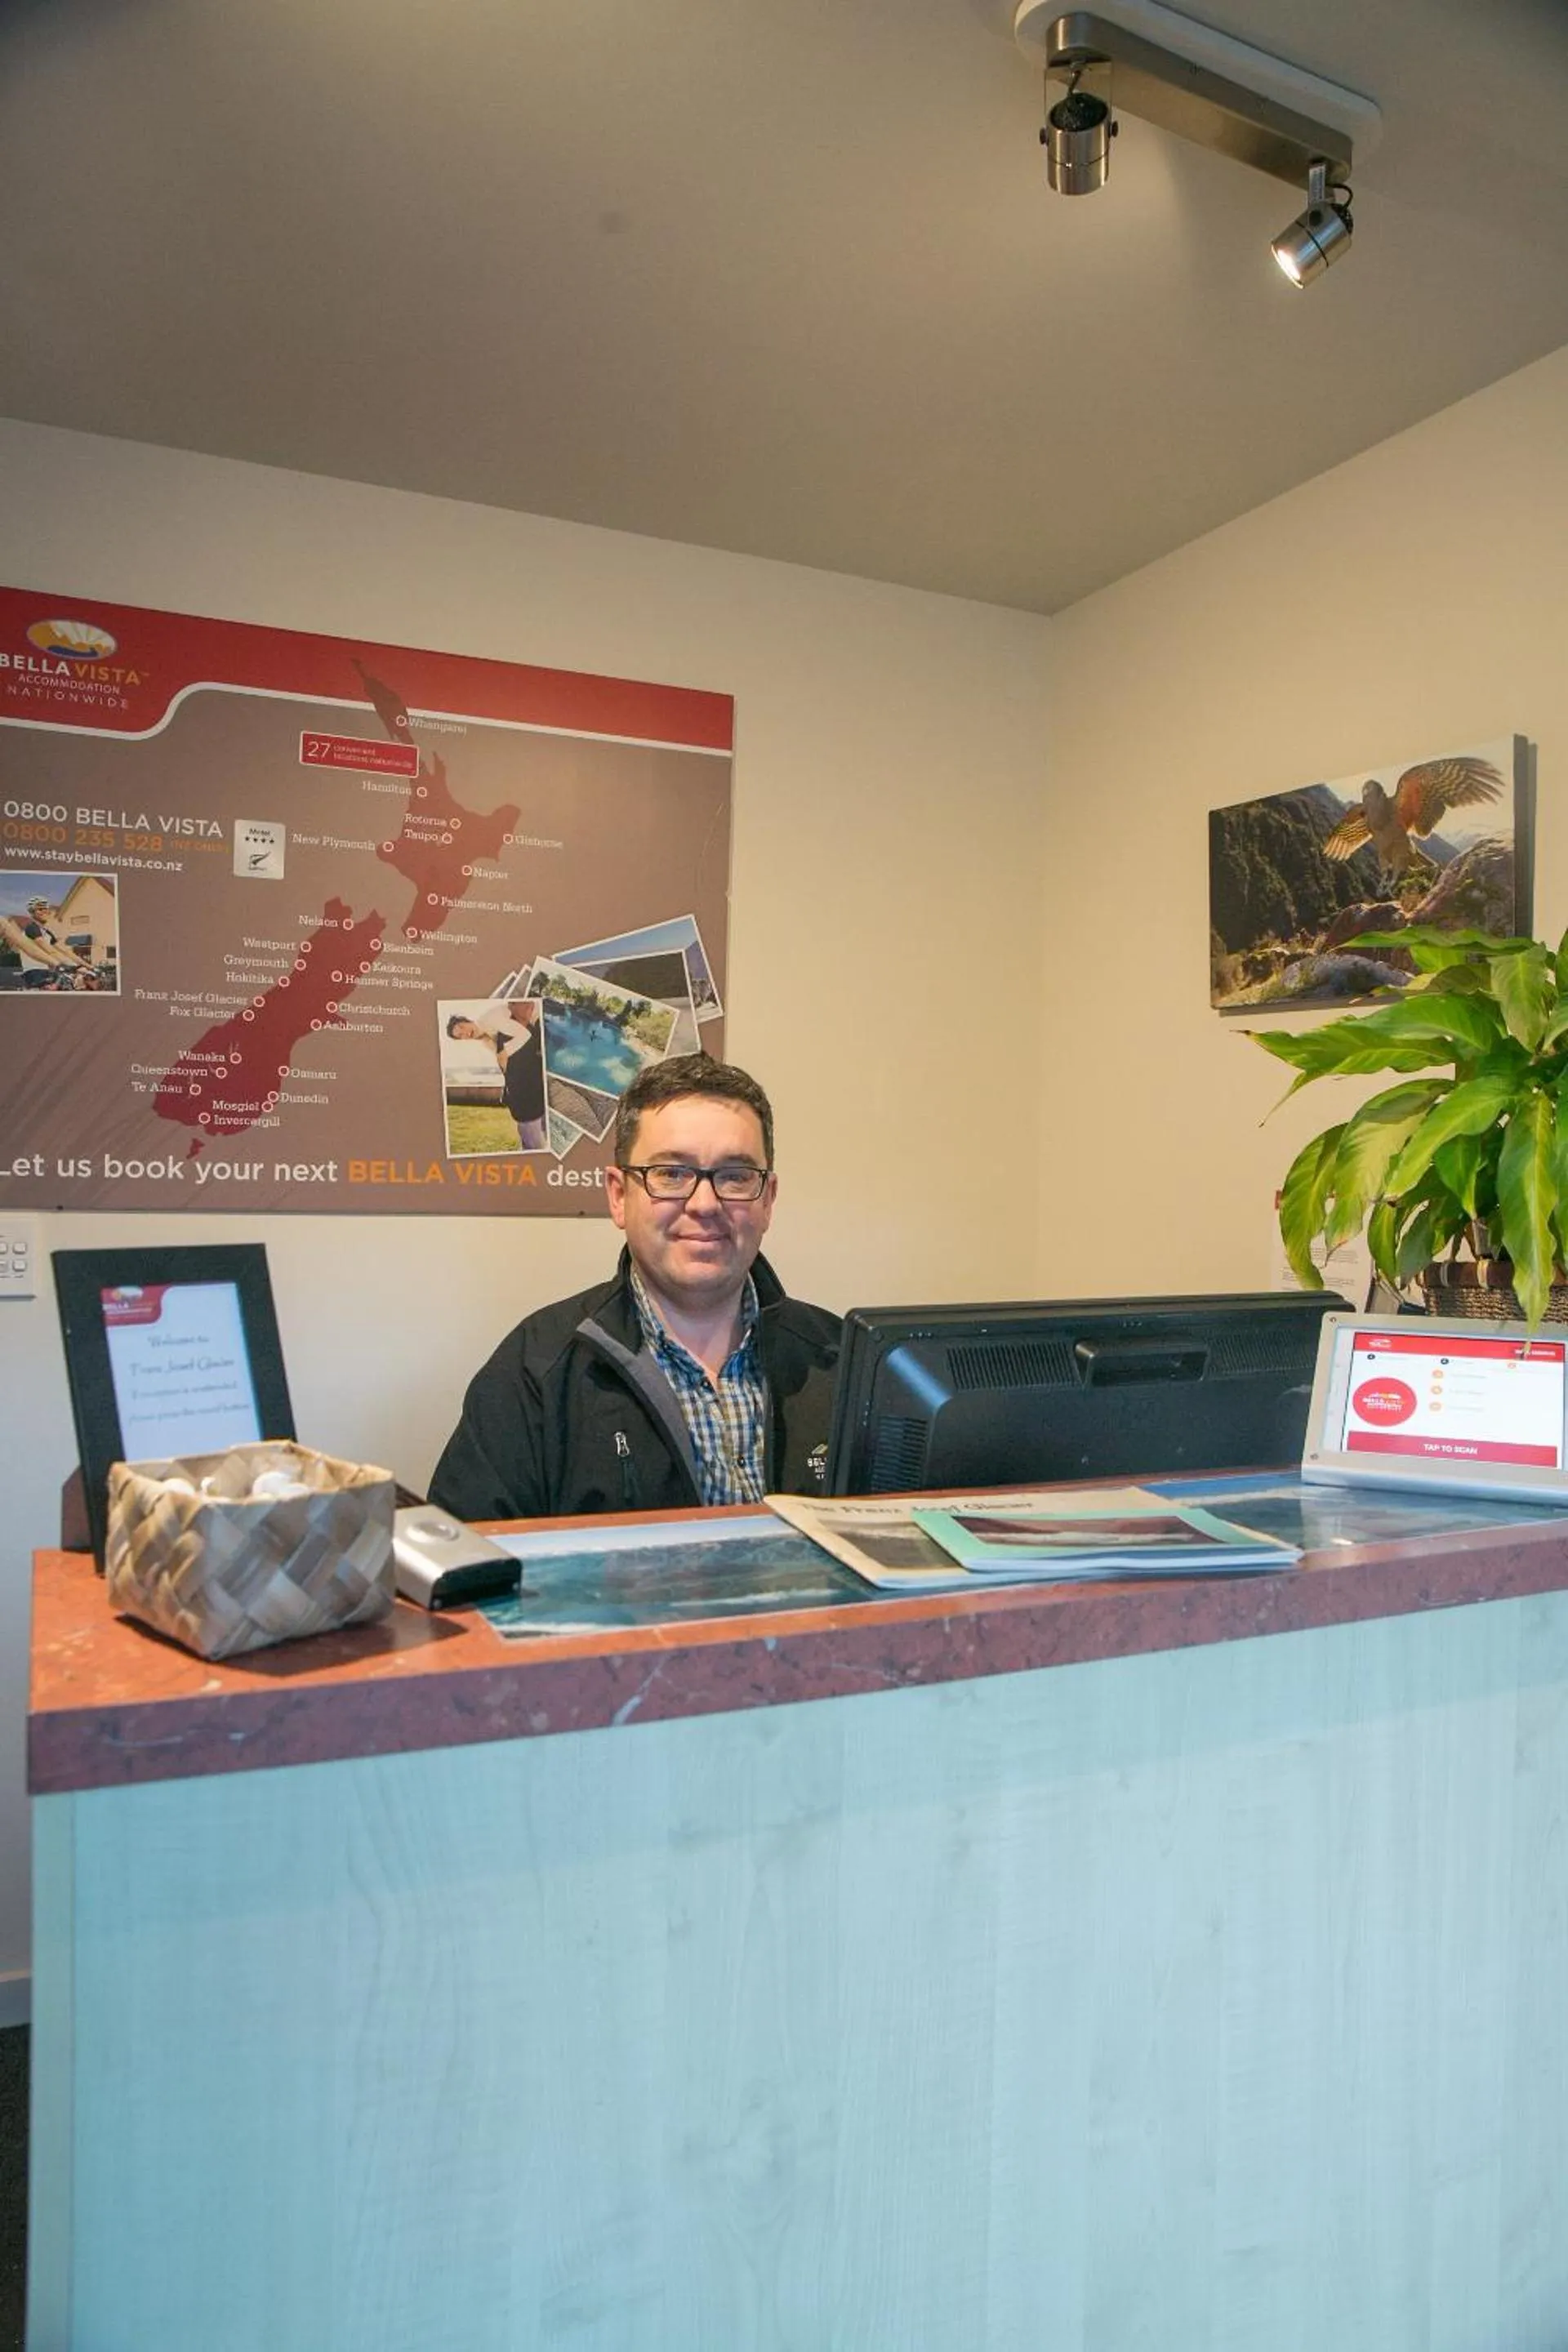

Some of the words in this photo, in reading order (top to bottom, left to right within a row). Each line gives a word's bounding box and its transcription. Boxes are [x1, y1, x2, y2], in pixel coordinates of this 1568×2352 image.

[0, 653, 70, 676] BELLA
[18, 674, 120, 695] ACCOMMODATION
[7, 685, 128, 709] NATIONWIDE
[308, 741, 331, 759] 27
[362, 781, 412, 795] Hamilton
[3, 800, 68, 822] 0800
[76, 807, 150, 831] BELLA
[158, 815, 223, 838] VISTA
[405, 813, 447, 827] Rotorua
[3, 822, 67, 843] 0800
[75, 829, 115, 849] 235
[124, 834, 163, 852] 528
[292, 833, 320, 845] New
[323, 835, 376, 852] Plymouth
[404, 829, 439, 843] Taupo
[4, 845, 184, 872] www.staybellavista.co.nz
[503, 901, 533, 914] North
[298, 915, 338, 927] Nelson
[420, 929, 478, 944] Wellington
[243, 938, 296, 951] Westport
[383, 942, 434, 956] Blenheim
[224, 954, 289, 969] Greymouth
[226, 971, 274, 984] Hokitika
[392, 978, 434, 991] Springs
[134, 989, 167, 1001] Franz
[171, 990, 202, 1003] Josef
[206, 992, 247, 1005] Glacier
[169, 1006, 192, 1017] Fox
[194, 1008, 236, 1020] Glacier
[339, 1003, 411, 1016] Christchurch
[323, 1020, 384, 1033] Ashburton
[178, 1050, 225, 1062] Wanaka
[131, 1063, 208, 1077] Queenstown
[291, 1067, 337, 1080] Oamaru
[131, 1080, 147, 1093] Te
[150, 1083, 183, 1094] Anau
[280, 1092, 328, 1104] Dunedin
[212, 1100, 260, 1113] Mosgiel
[214, 1115, 280, 1128] Invercargill
[57, 1159, 92, 1178] us
[104, 1153, 185, 1179] book
[194, 1160, 265, 1184] your
[274, 1161, 338, 1182] next
[348, 1160, 445, 1183] BELLA
[452, 1163, 537, 1186] VISTA
[546, 1165, 604, 1187] dest
